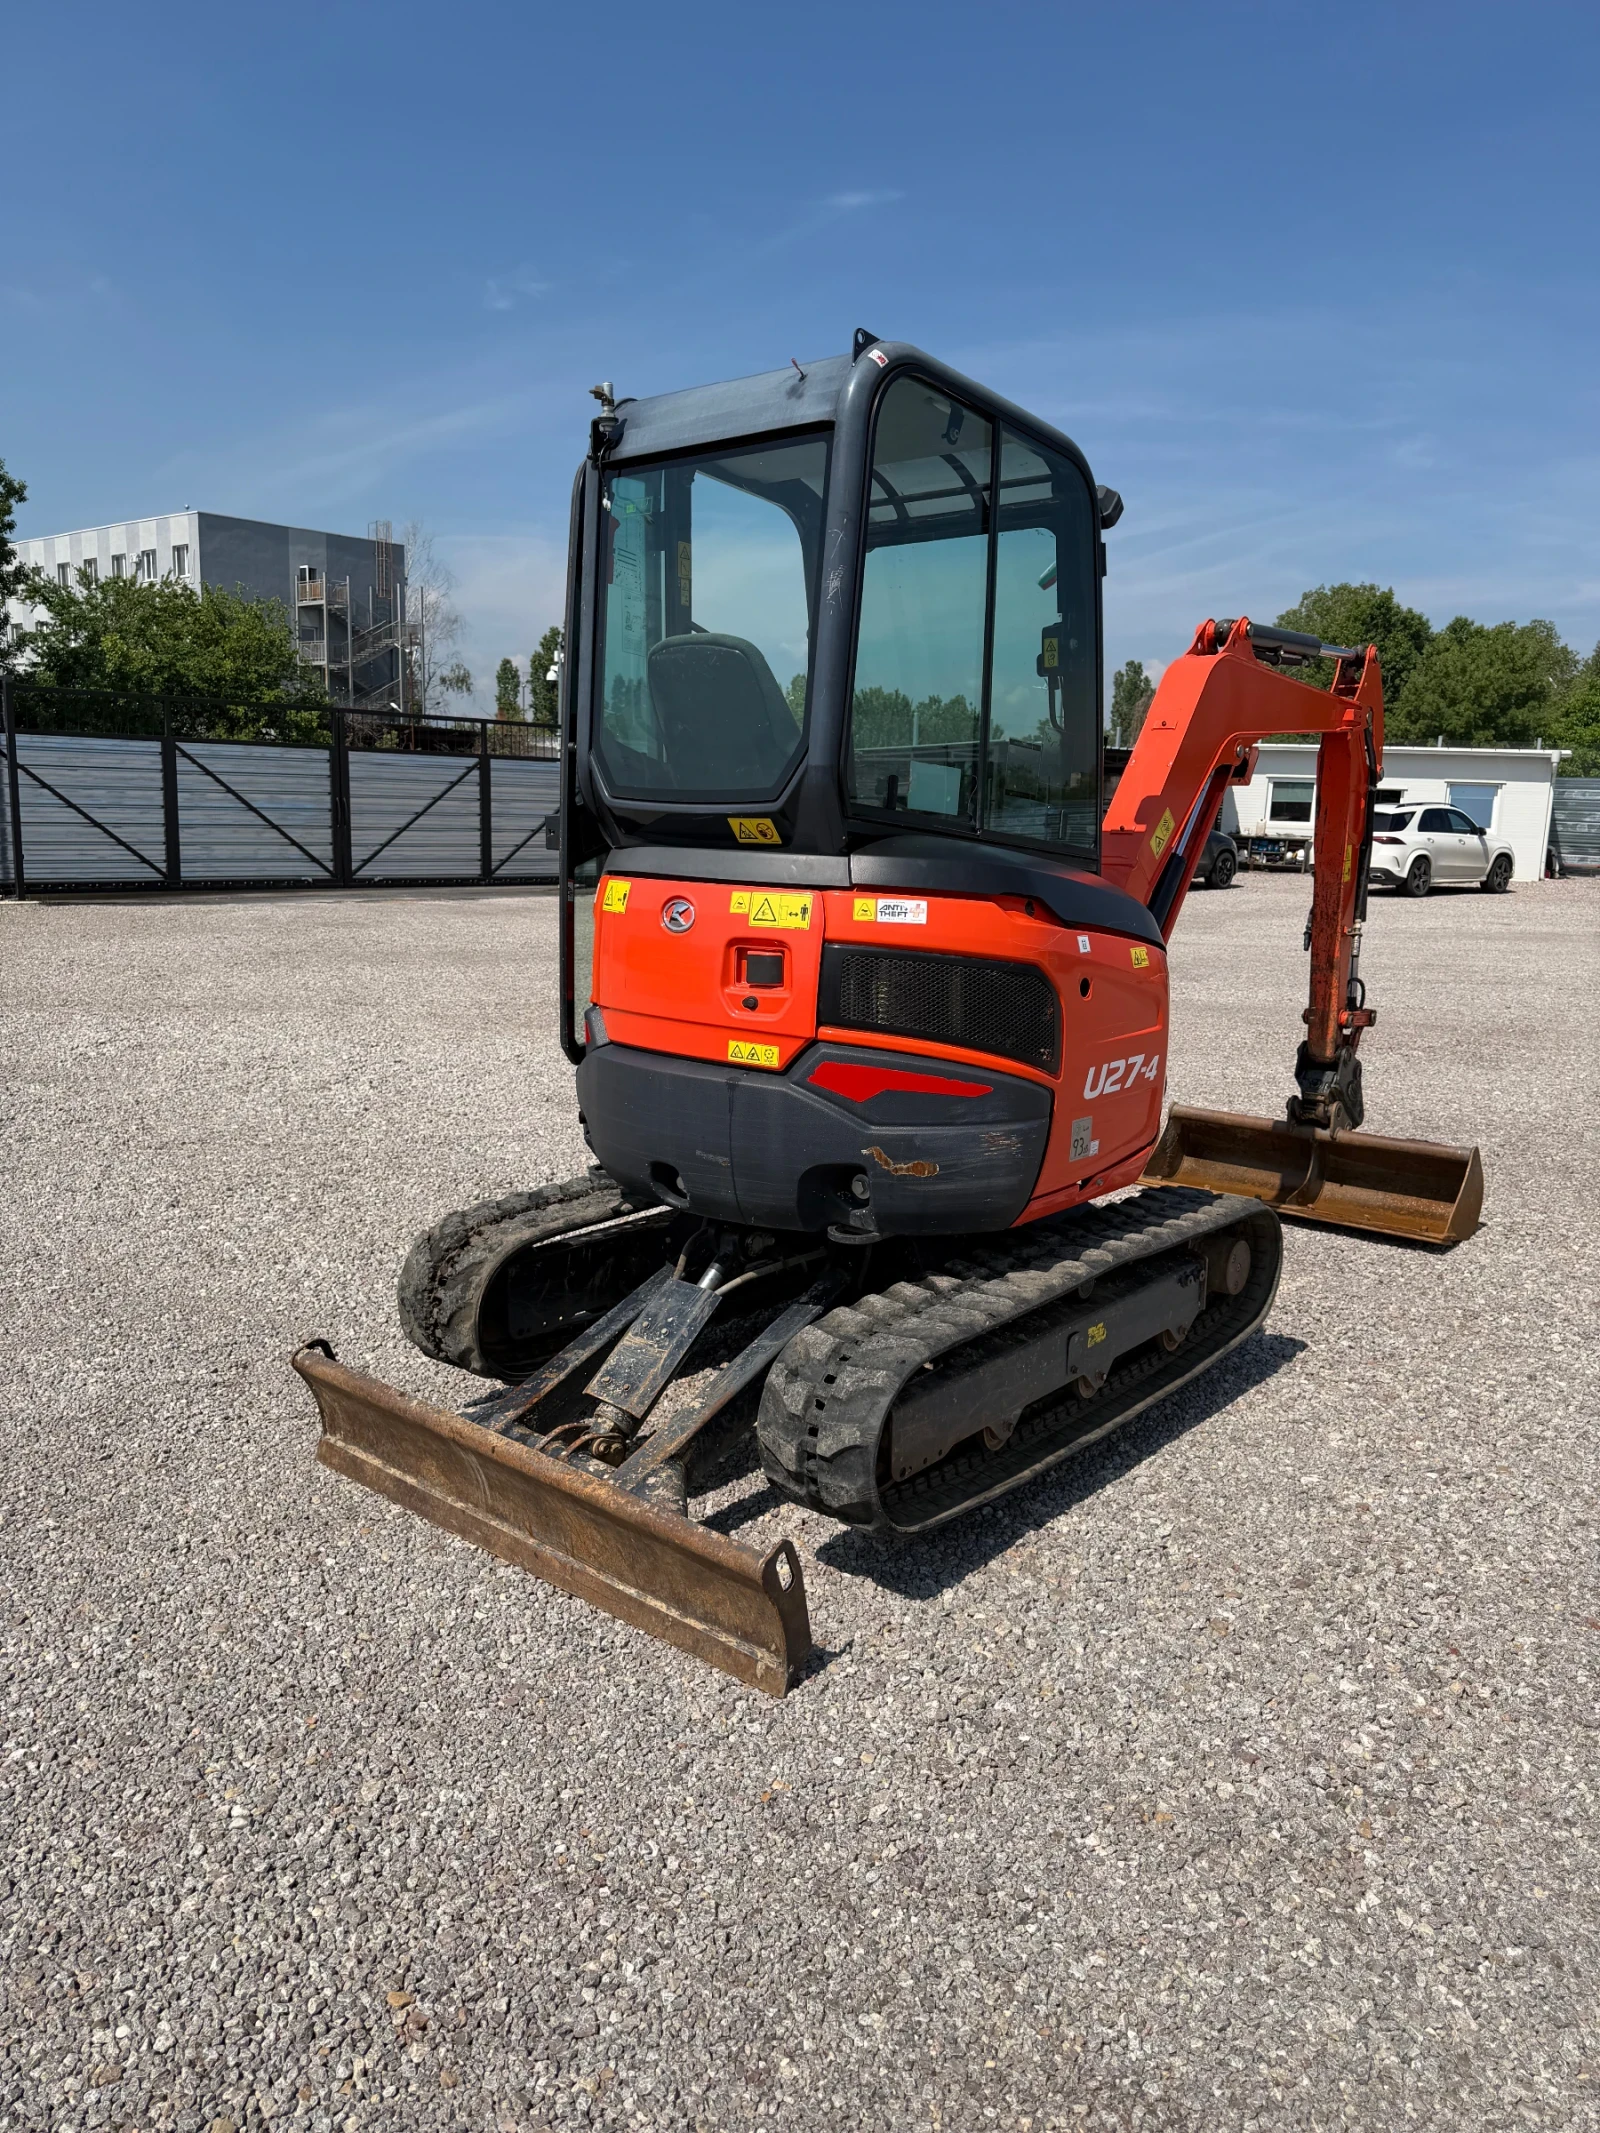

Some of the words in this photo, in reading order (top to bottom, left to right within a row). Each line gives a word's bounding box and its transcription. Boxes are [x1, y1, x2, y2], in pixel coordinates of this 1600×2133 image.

[879, 910, 908, 918] THEFT
[1083, 1053, 1160, 1100] U27-4
[1073, 1137, 1084, 1157] 93
